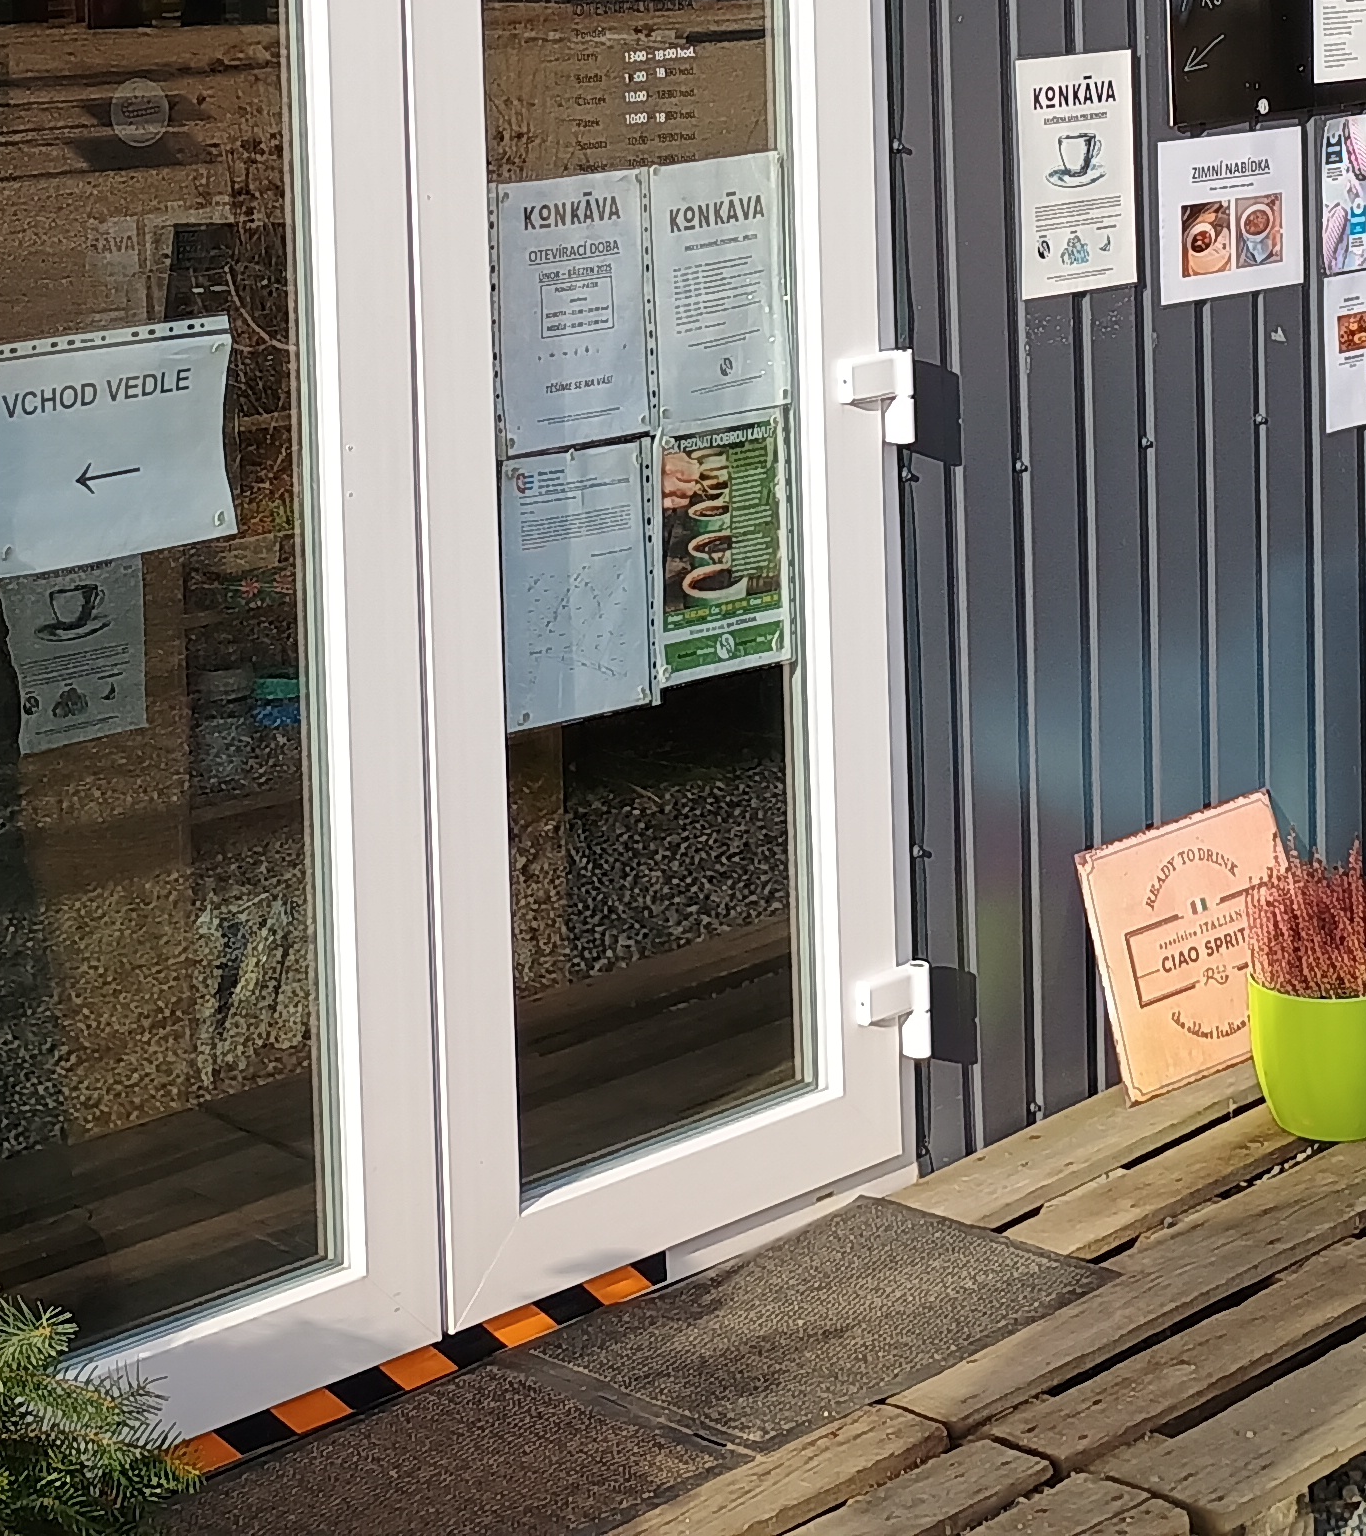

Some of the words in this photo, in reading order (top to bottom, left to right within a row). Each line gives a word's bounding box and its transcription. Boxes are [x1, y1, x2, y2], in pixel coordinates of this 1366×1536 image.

[624, 51, 647, 62] 13:00
[655, 48, 676, 61] 18:00
[677, 46, 696, 58] hod.
[625, 112, 648, 124] 10:00
[1191, 159, 1224, 181] ZIMNÍ
[1225, 156, 1271, 176] NABÍDKA
[528, 239, 588, 263] OTEVÍRACÍ
[589, 239, 620, 255] DOBA
[2, 382, 98, 419] VCHOD
[105, 367, 192, 401] VEDLE
[1145, 857, 1176, 912] READY
[1177, 847, 1196, 866] TO
[1197, 846, 1239, 878] DRINK
[1198, 909, 1245, 935] ITALIAN
[1161, 945, 1200, 974] CIAO
[1204, 926, 1246, 958] SPRIT
